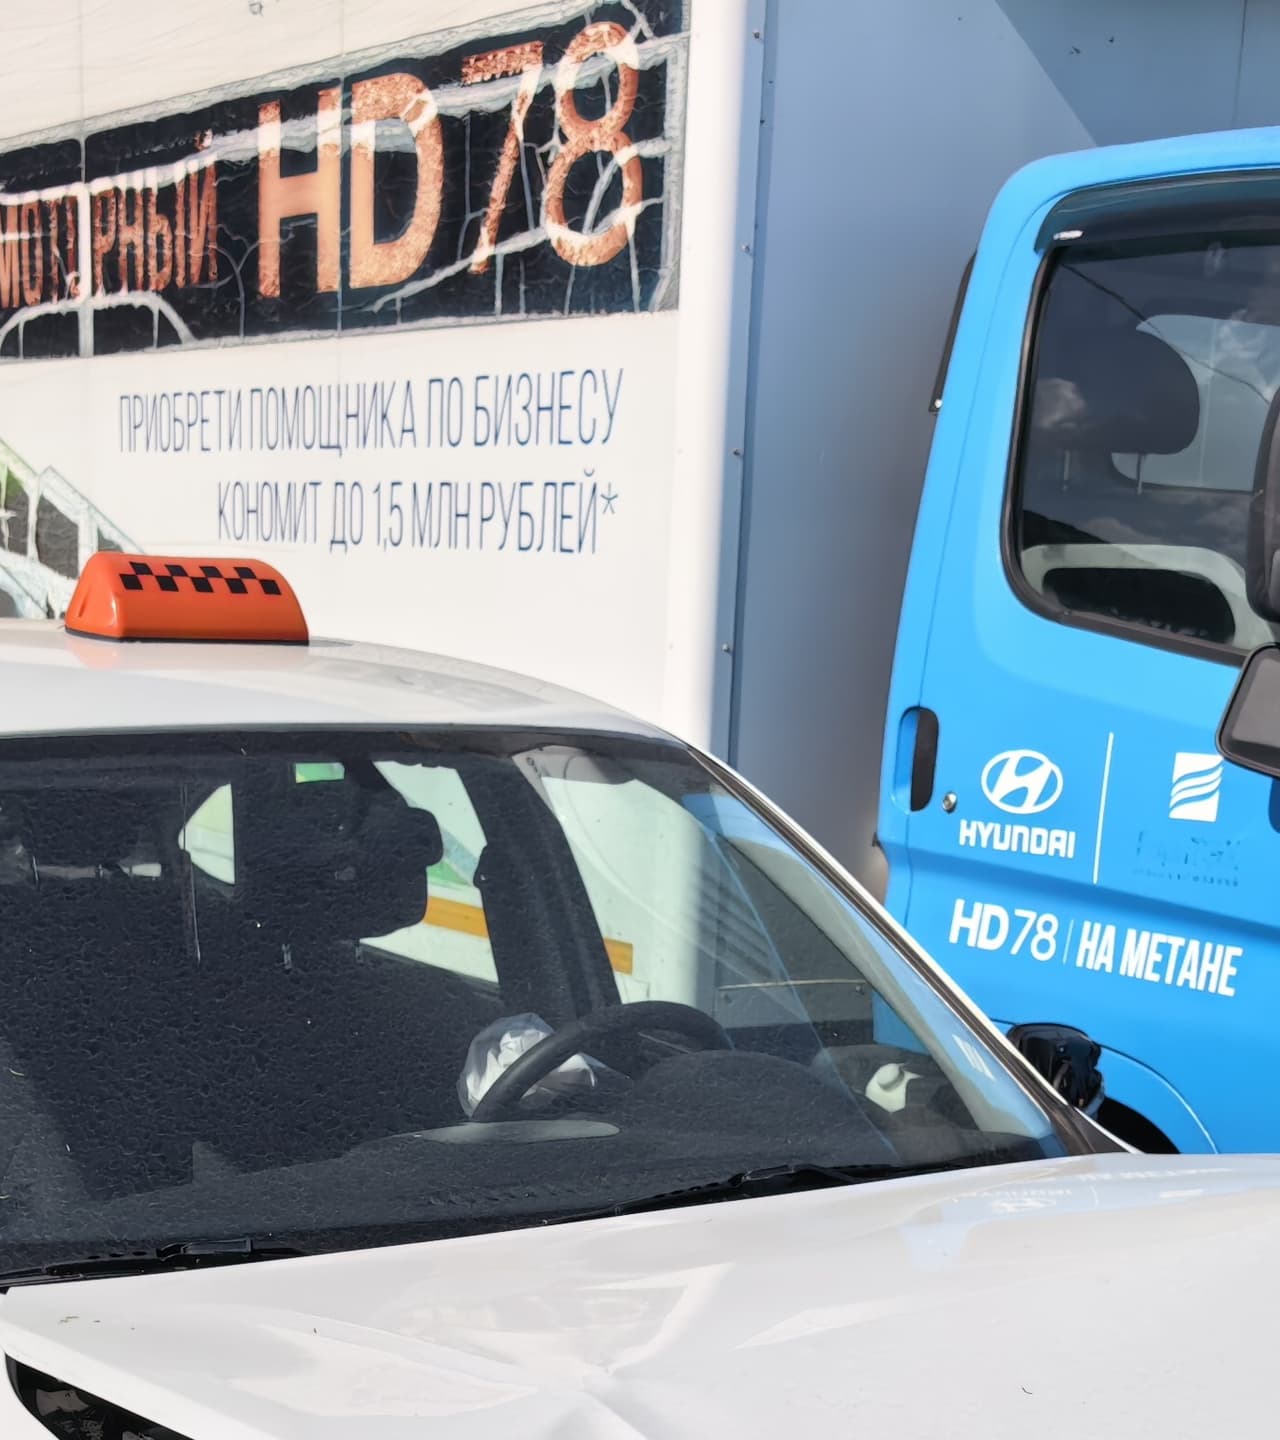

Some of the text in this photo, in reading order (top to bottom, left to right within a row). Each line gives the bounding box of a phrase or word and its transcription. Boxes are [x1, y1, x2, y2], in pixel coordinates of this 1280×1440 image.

[119, 367, 625, 458] ПРИОБРЕТИ ПОМОЩНИКА ПО БИЗНЕСУ
[218, 480, 322, 544] КОНОМИТ
[329, 480, 364, 553] ДО
[411, 481, 472, 551] МЛН
[958, 819, 1076, 859] HYUNDAI
[1075, 920, 1115, 973] НА
[1119, 928, 1244, 998] МЕТАНЕ
